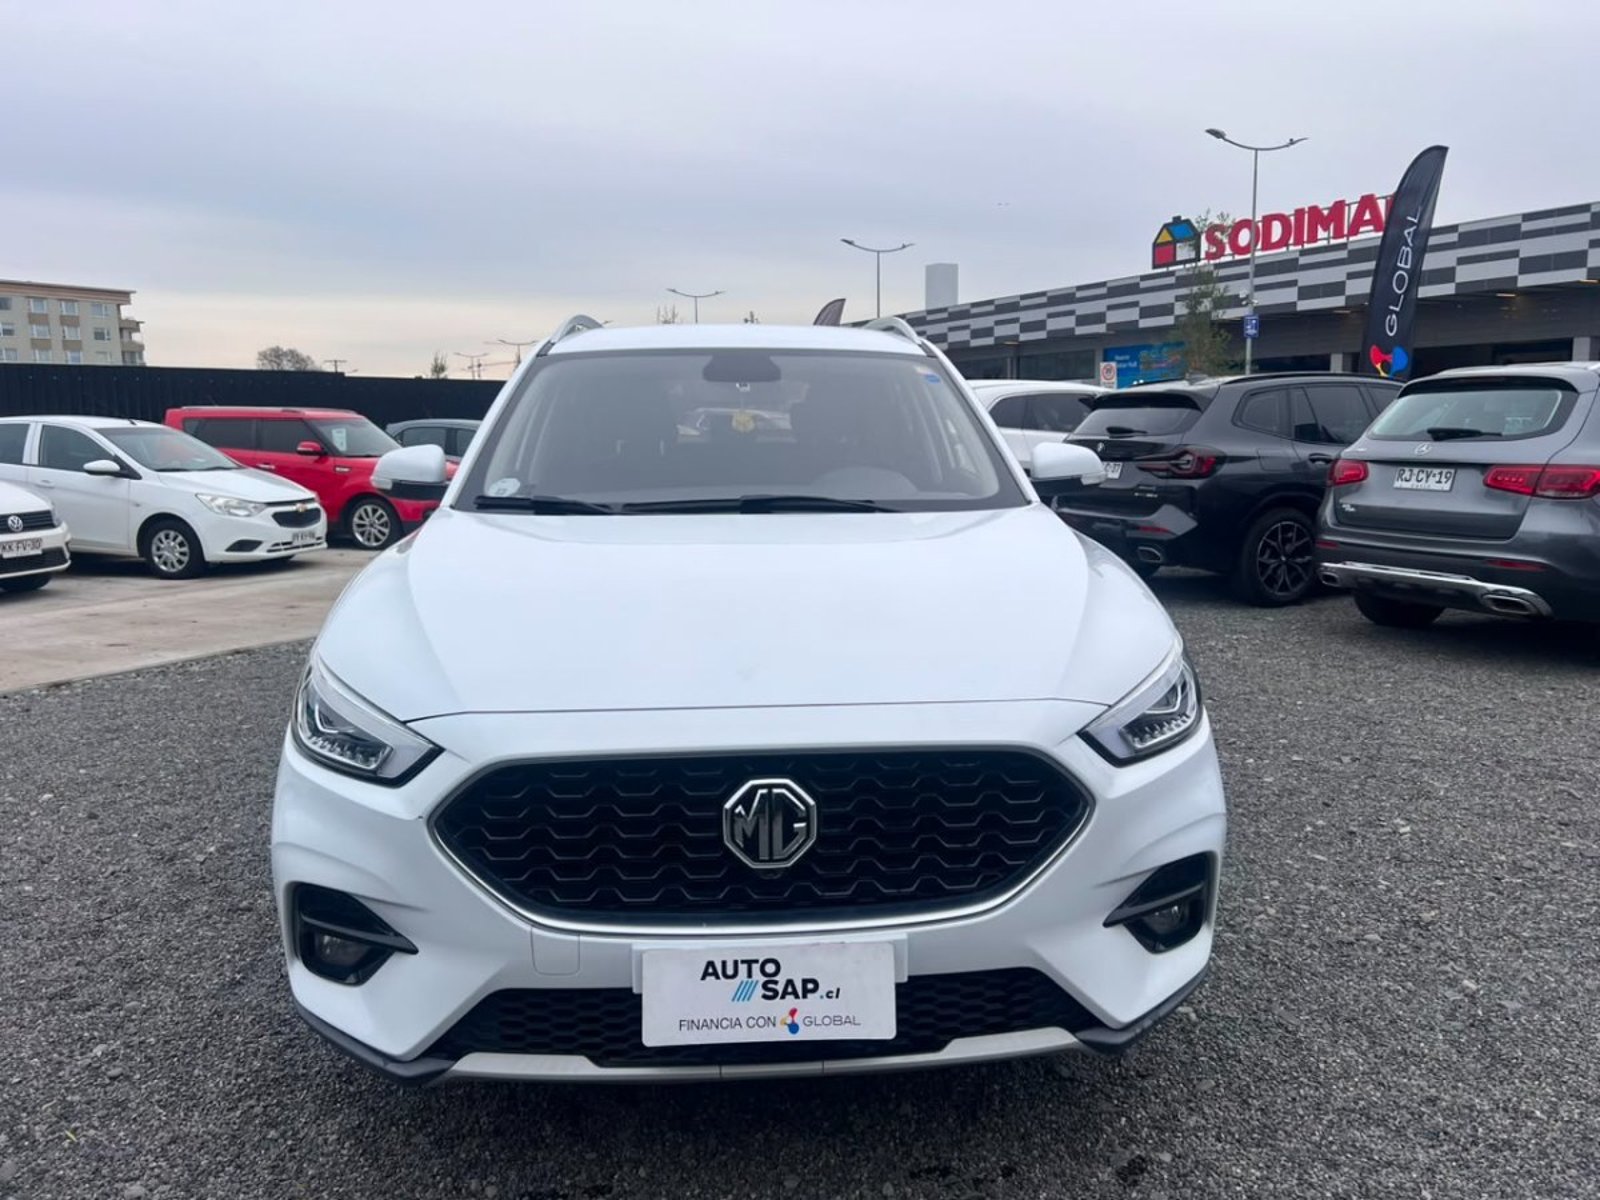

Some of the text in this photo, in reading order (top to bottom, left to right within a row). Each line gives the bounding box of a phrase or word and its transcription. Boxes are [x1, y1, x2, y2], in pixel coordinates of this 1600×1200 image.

[1384, 206, 1421, 337] GLOBAL
[733, 788, 807, 860] MG
[700, 957, 781, 981] AUTO
[679, 1015, 861, 1032] FINANCIA CON GLOBAL
